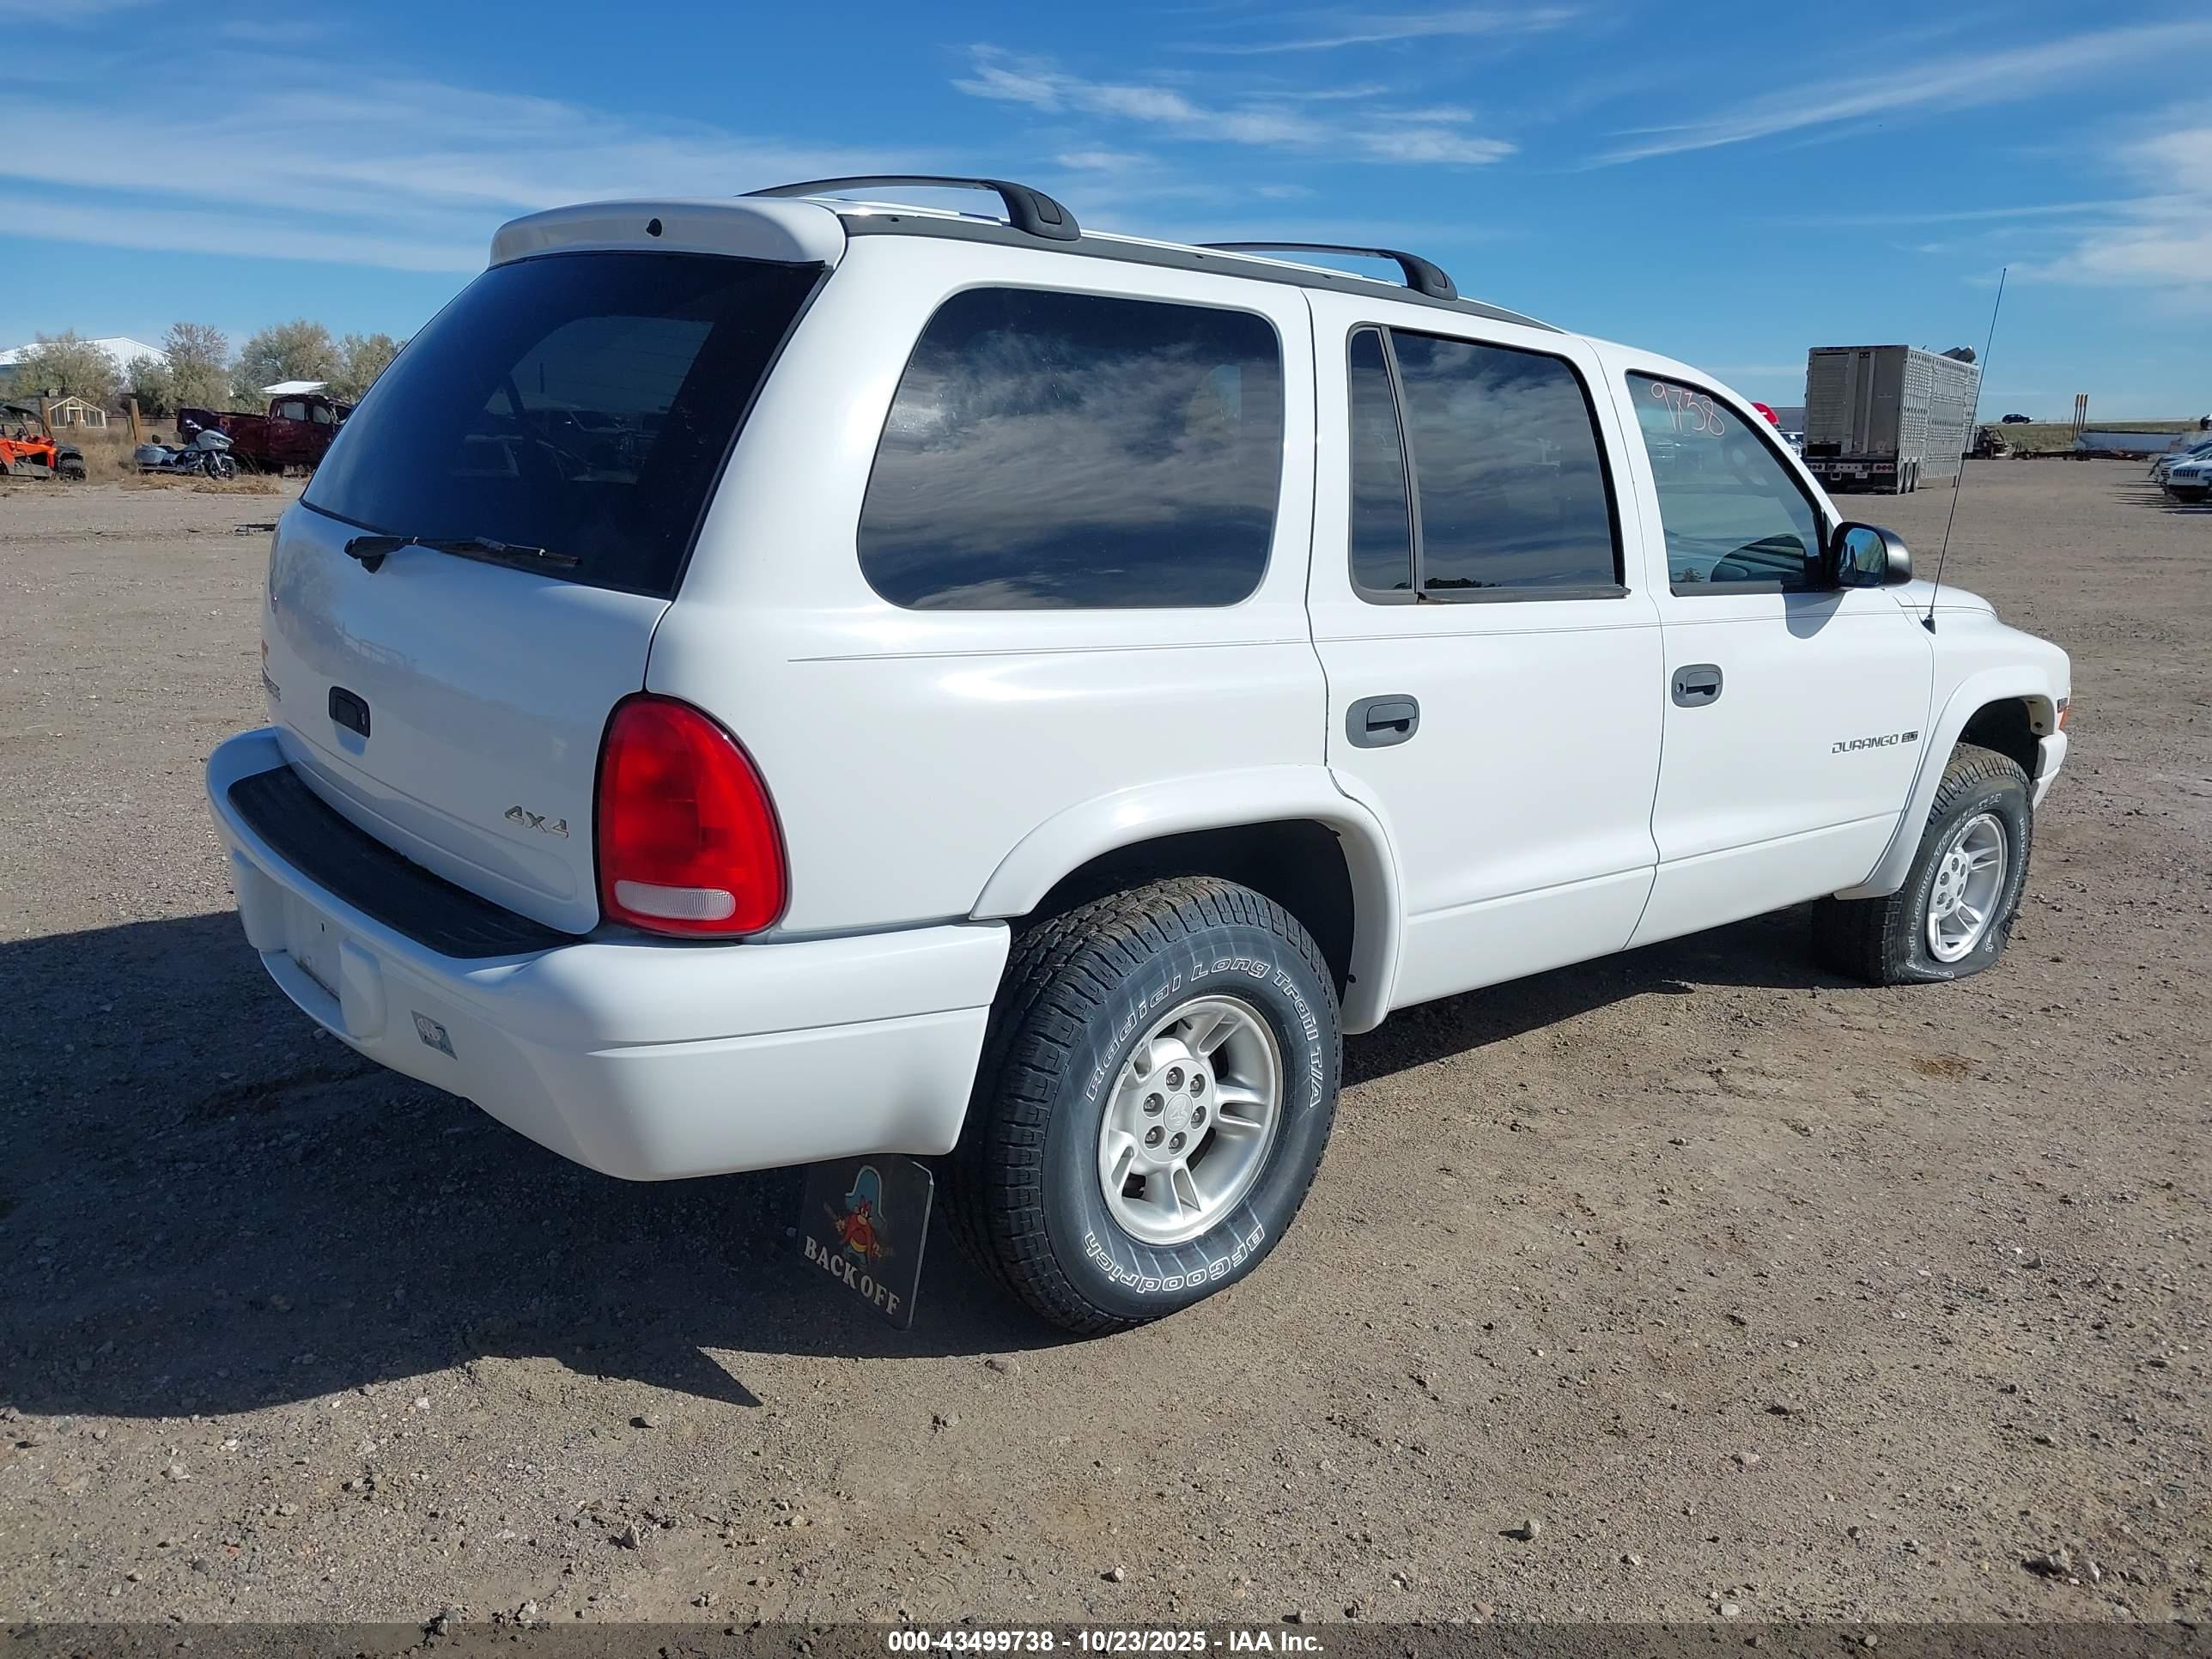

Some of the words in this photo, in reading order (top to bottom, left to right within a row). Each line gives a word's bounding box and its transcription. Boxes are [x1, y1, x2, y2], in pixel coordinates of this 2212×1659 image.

[1832, 733, 1899, 754] DURANGO
[1085, 974, 1182, 1103] Radial
[1190, 957, 1269, 982] Long
[1272, 968, 1319, 1041] Trail
[1307, 1045, 1322, 1109] T/A
[804, 1236, 858, 1289] BACK
[860, 1274, 900, 1316] OFF
[1084, 1224, 1267, 1294] BFGoodrich
